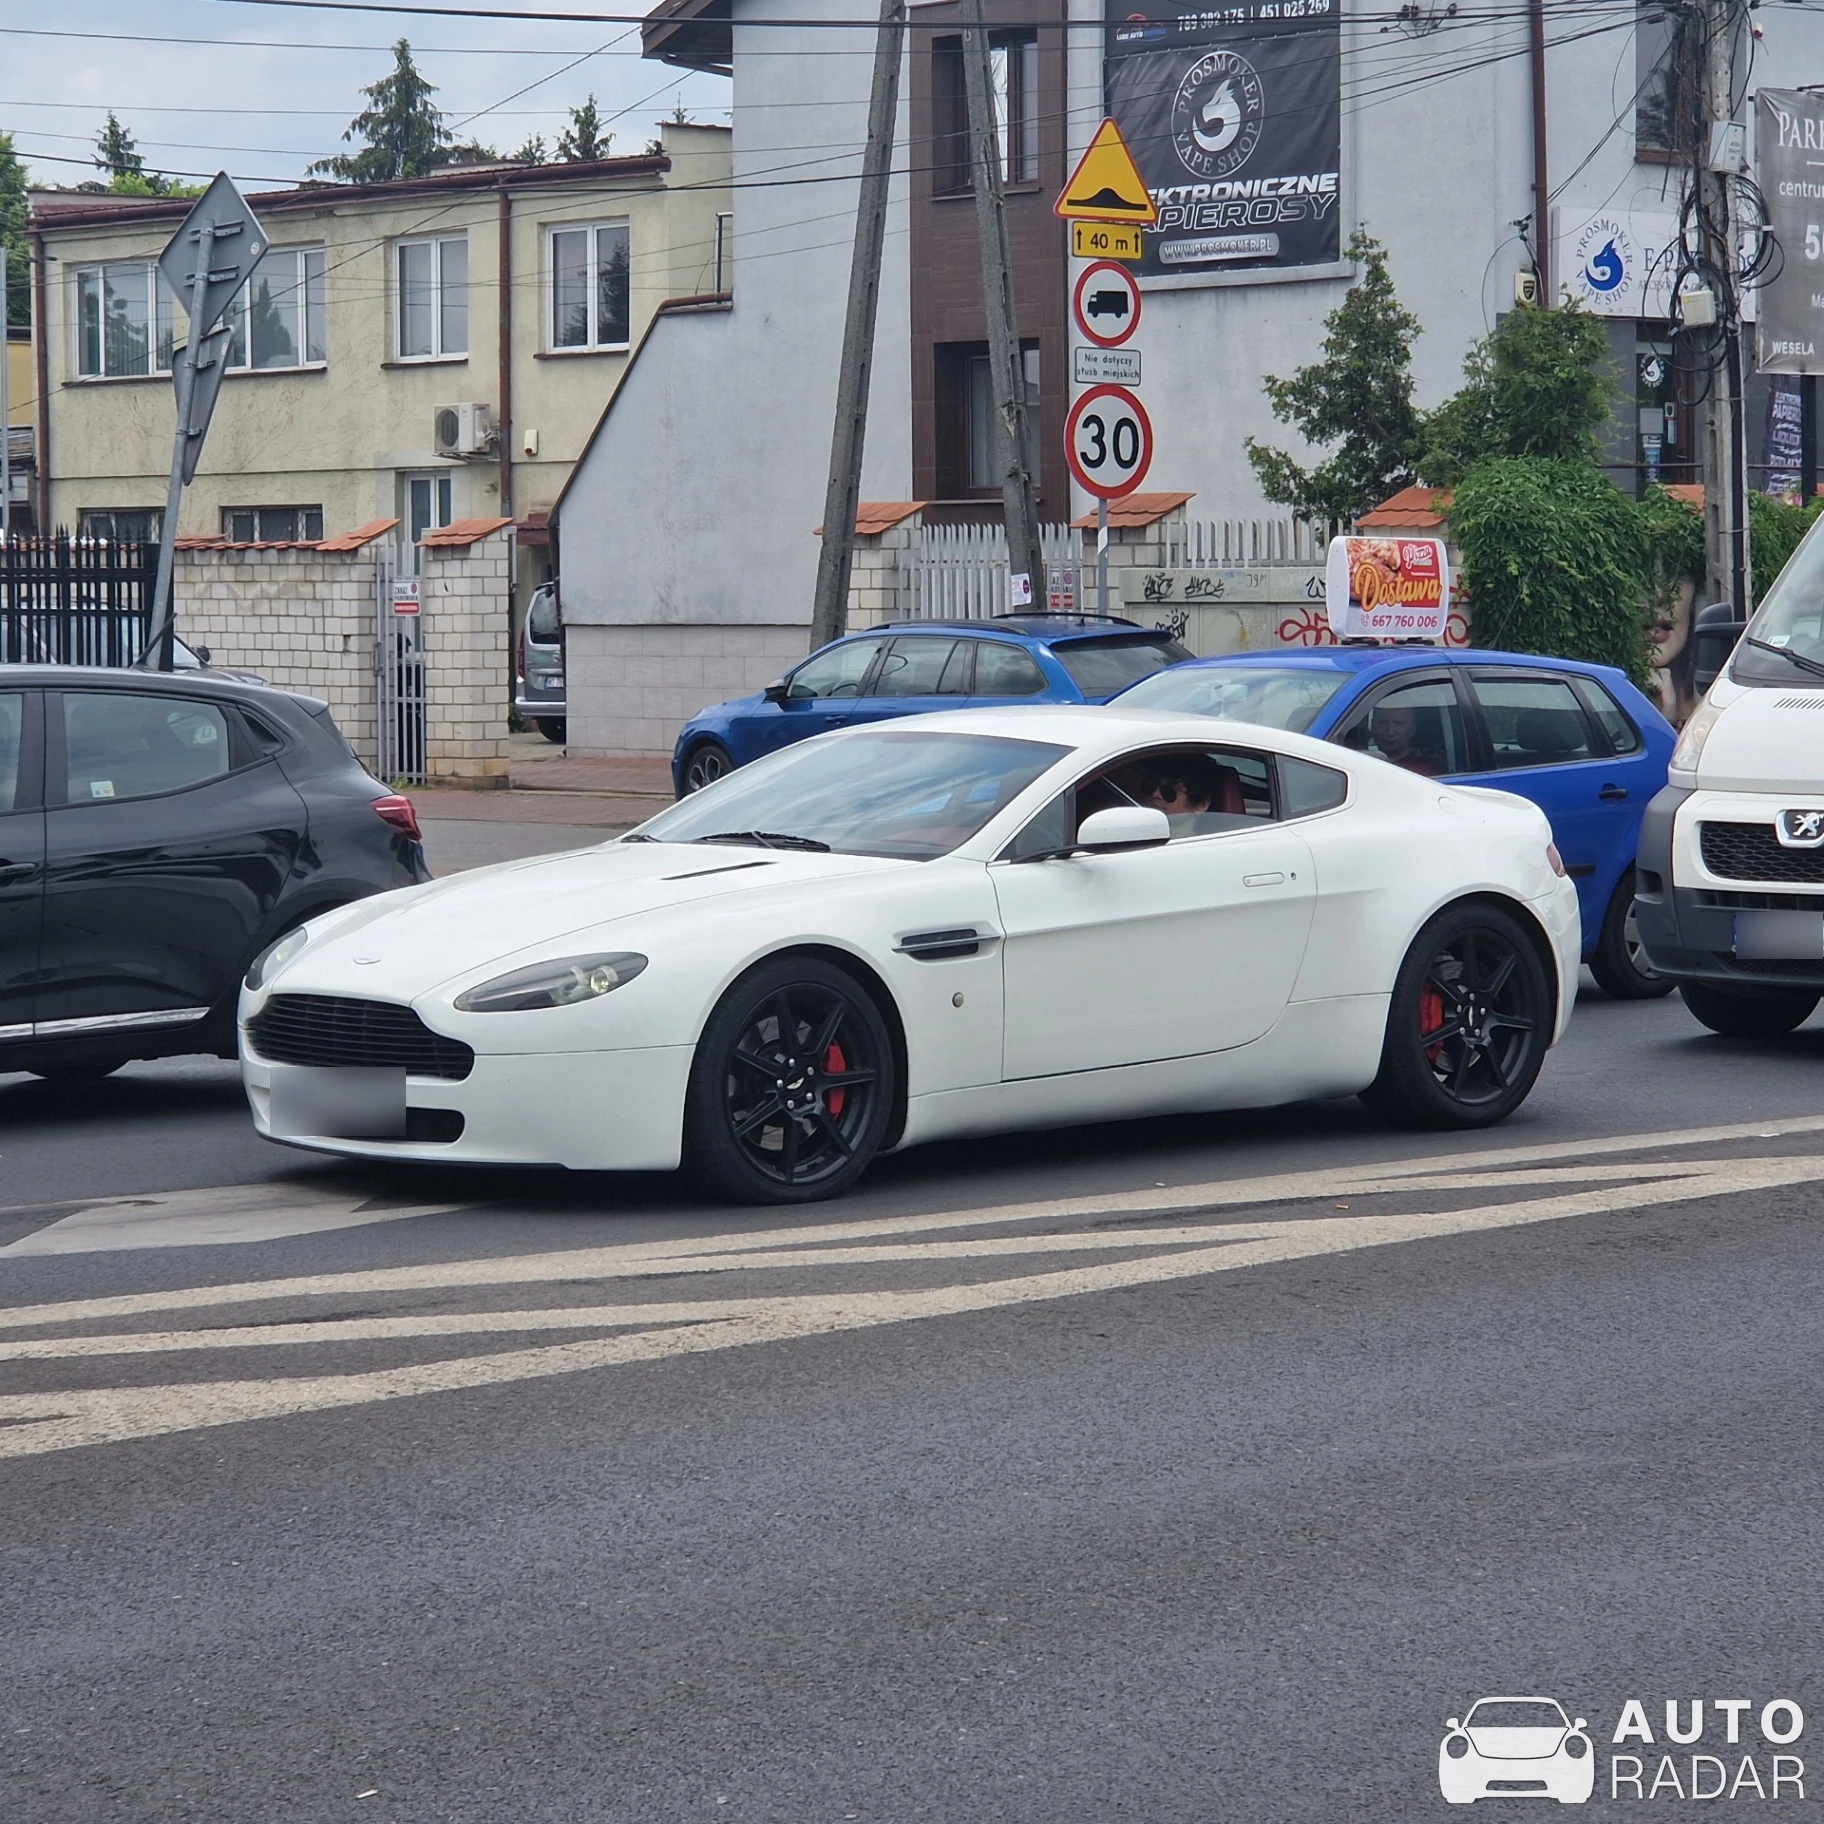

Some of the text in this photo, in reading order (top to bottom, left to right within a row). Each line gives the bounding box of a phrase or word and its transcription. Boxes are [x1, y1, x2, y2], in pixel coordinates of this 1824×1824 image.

[1259, 3, 1280, 18] 451
[1283, 0, 1305, 17] 025
[1308, 0, 1330, 15] 269
[1178, 53, 1260, 114] PROSMOKER
[1176, 121, 1259, 174] VAPE SHOP
[1090, 232, 1128, 251] 40 m
[1576, 218, 1633, 265] PROSMOKER
[1576, 269, 1633, 306] VAPE SHOP
[1084, 353, 1133, 367] Nie dotyczy
[1772, 340, 1815, 355] WESELA
[1103, 368, 1140, 380] miejskich
[1079, 414, 1140, 470] 30
[1354, 562, 1442, 612] Dostawa
[1372, 615, 1438, 628] 667 760 006
